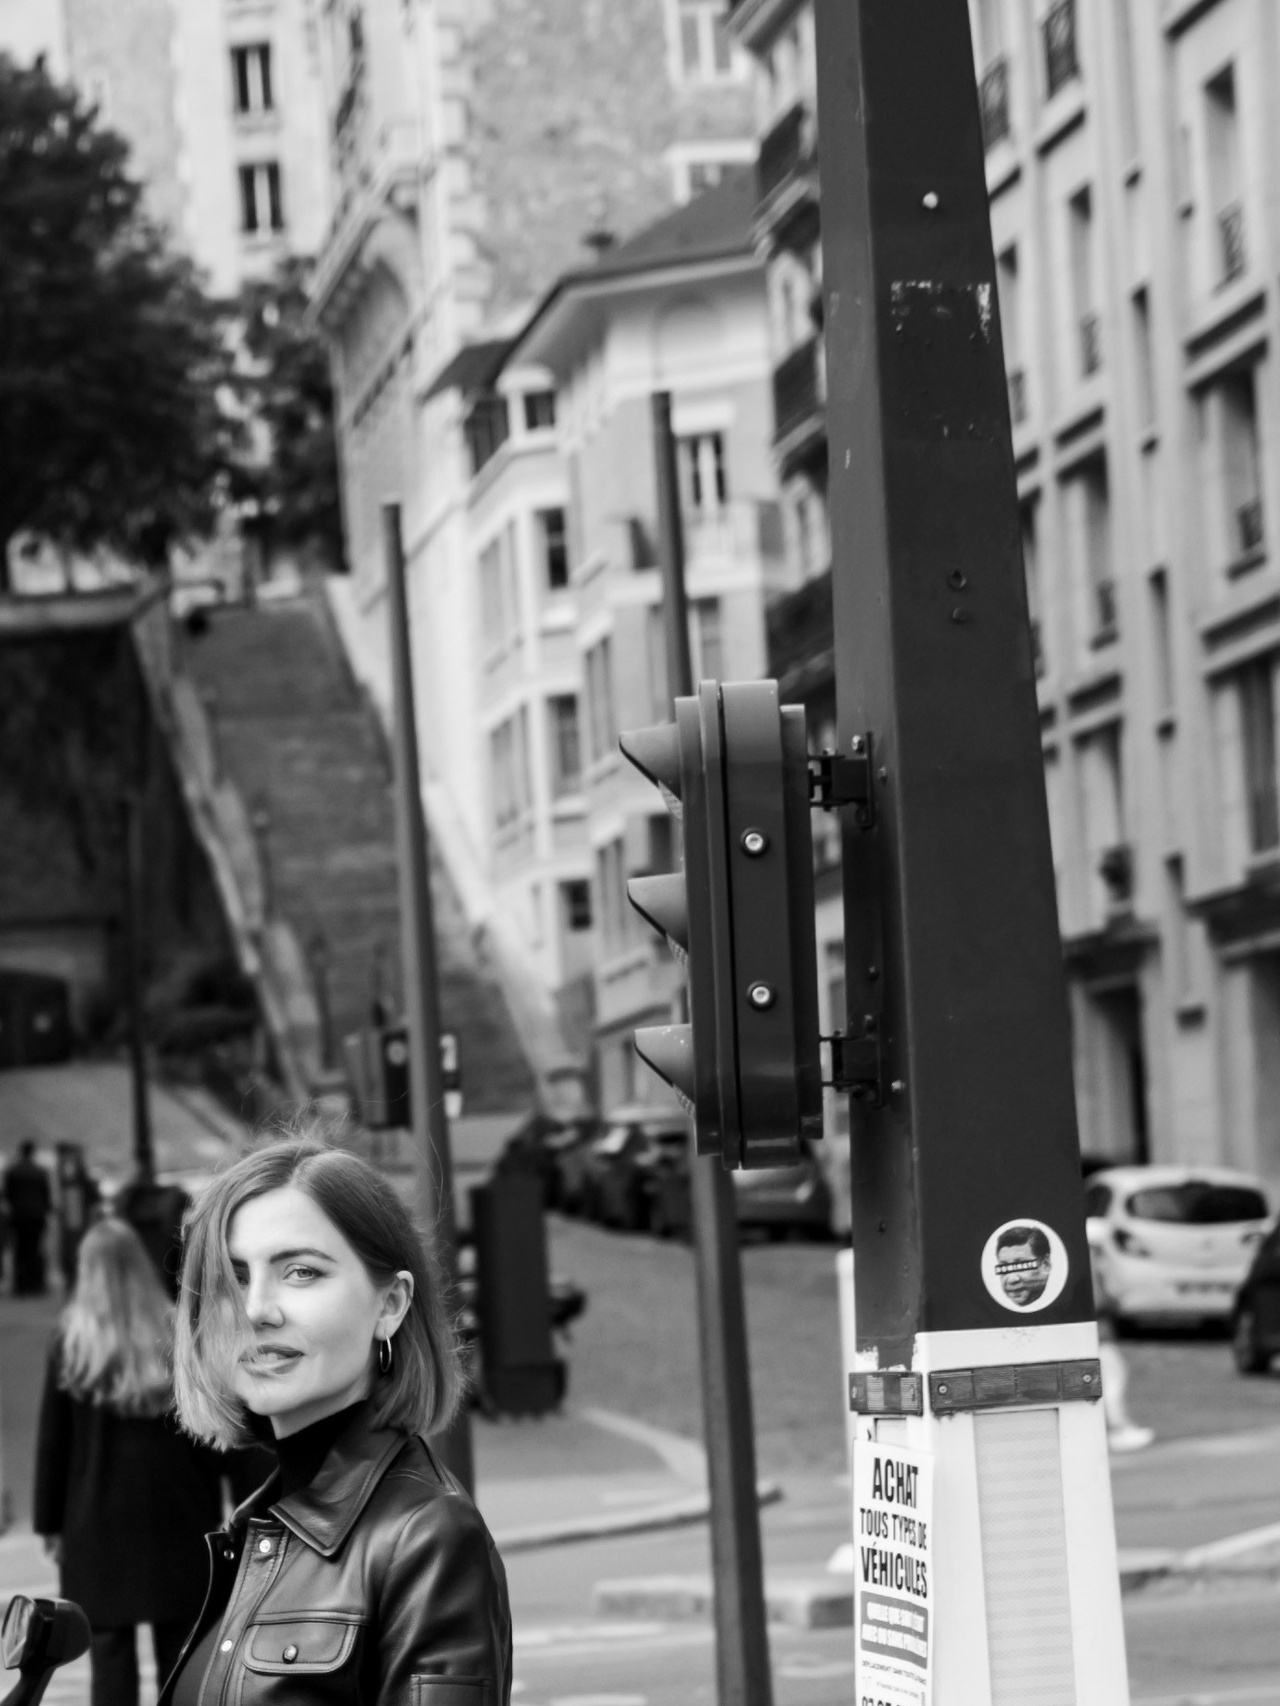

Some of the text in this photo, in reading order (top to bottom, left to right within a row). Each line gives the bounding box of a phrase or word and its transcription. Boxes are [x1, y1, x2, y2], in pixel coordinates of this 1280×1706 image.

[872, 1457, 919, 1509] ACHAT
[860, 1508, 927, 1550] TOUS TYPES DE
[860, 1541, 928, 1599] VÉHICULES
